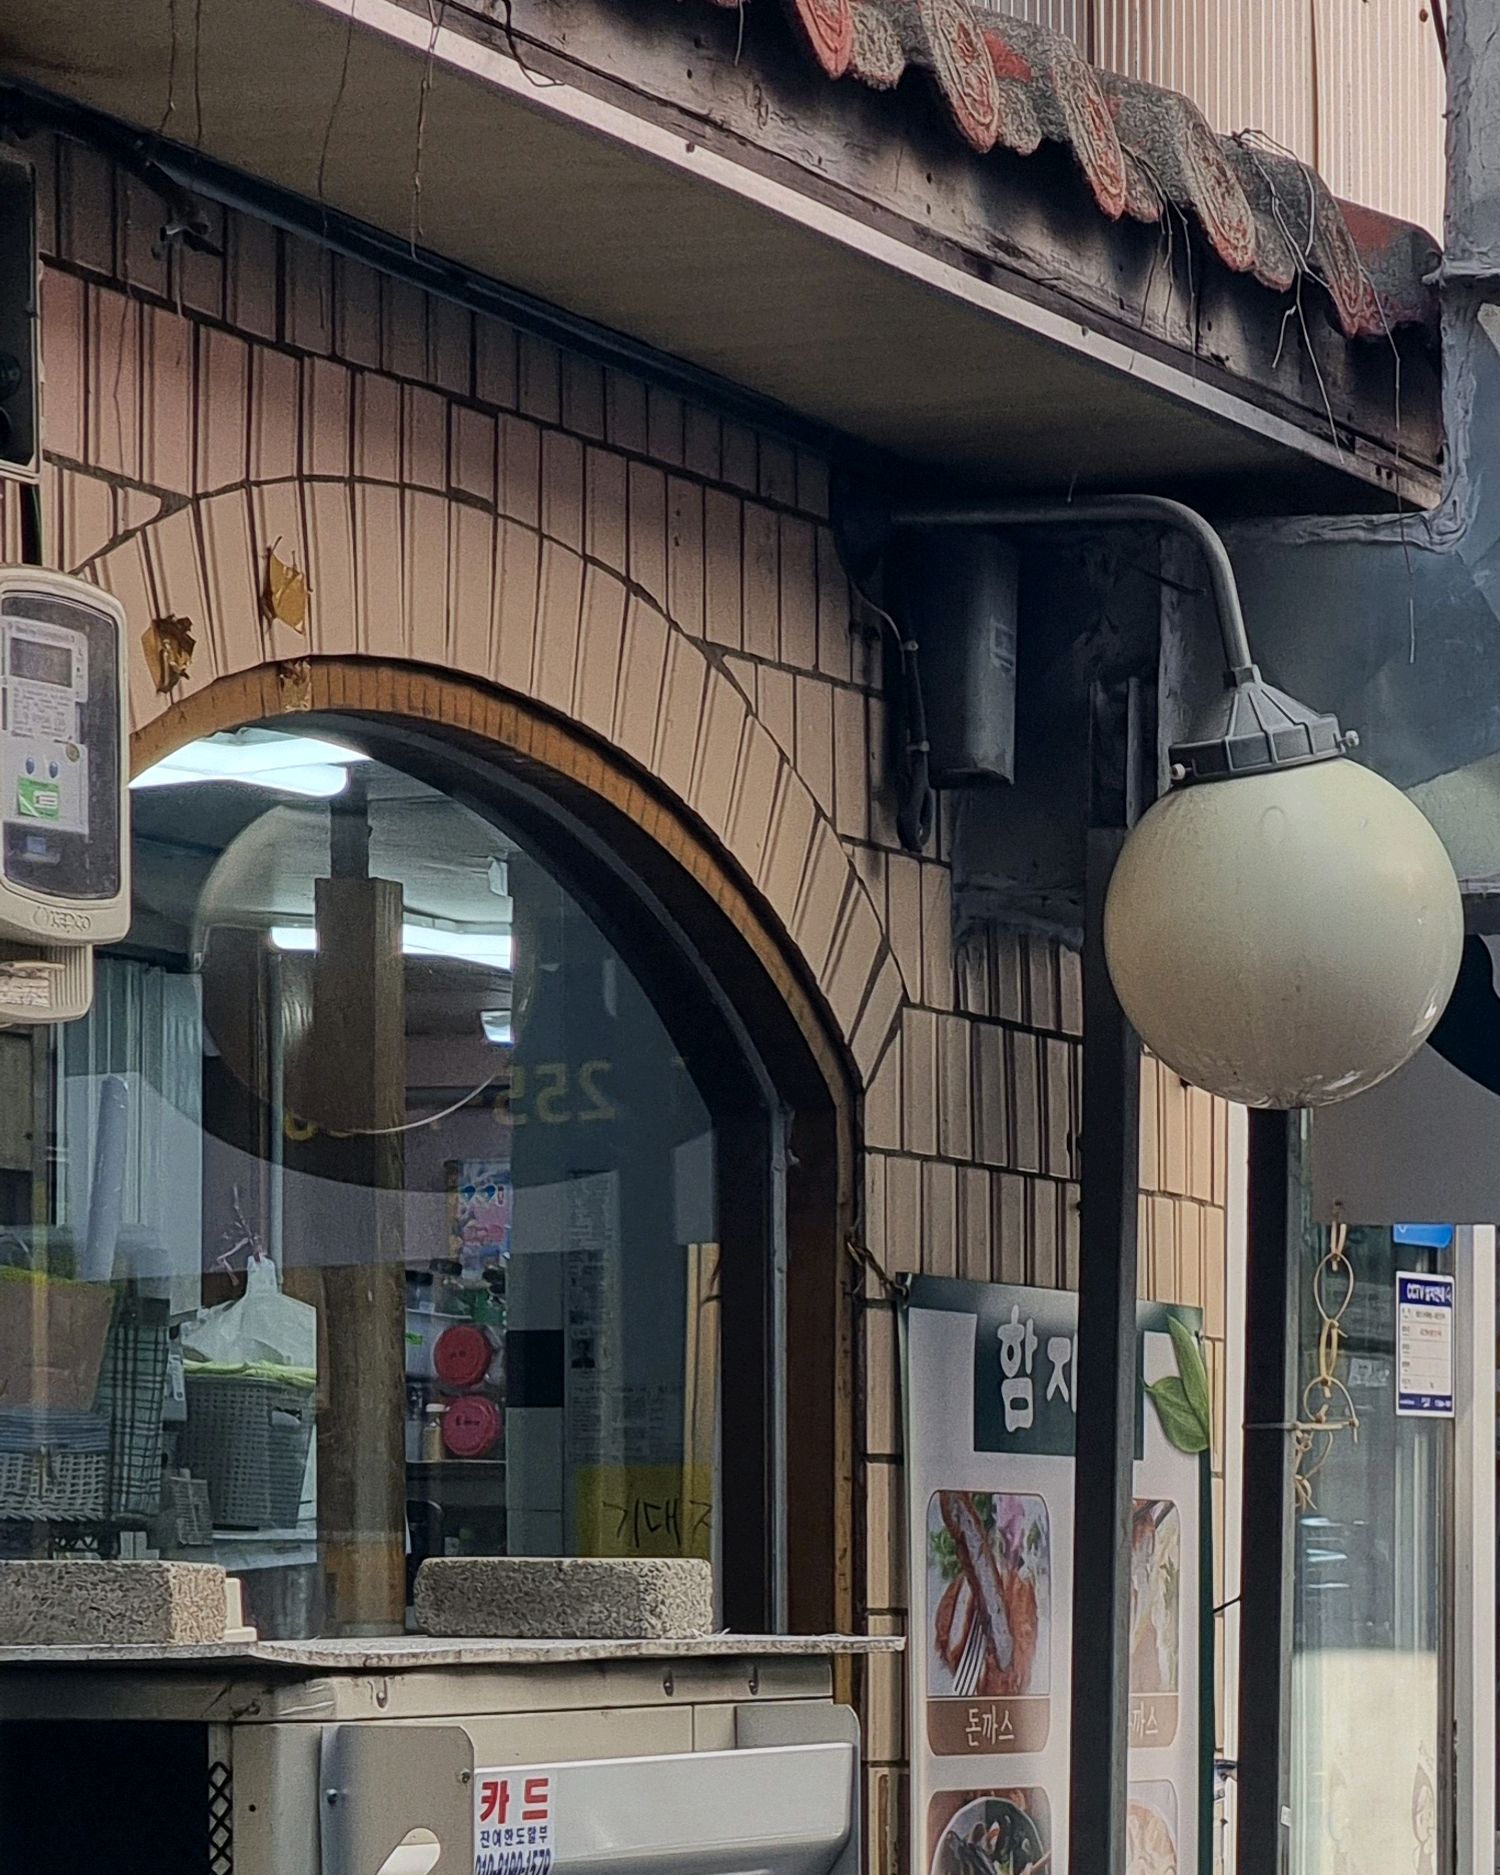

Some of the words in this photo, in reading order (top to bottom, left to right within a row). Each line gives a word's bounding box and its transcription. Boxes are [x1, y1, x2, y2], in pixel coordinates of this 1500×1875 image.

[997, 1304, 1079, 1433] 함지
[965, 1704, 1016, 1747] 돈까스
[1130, 1701, 1159, 1739] 까스
[479, 1777, 550, 1825] 카드
